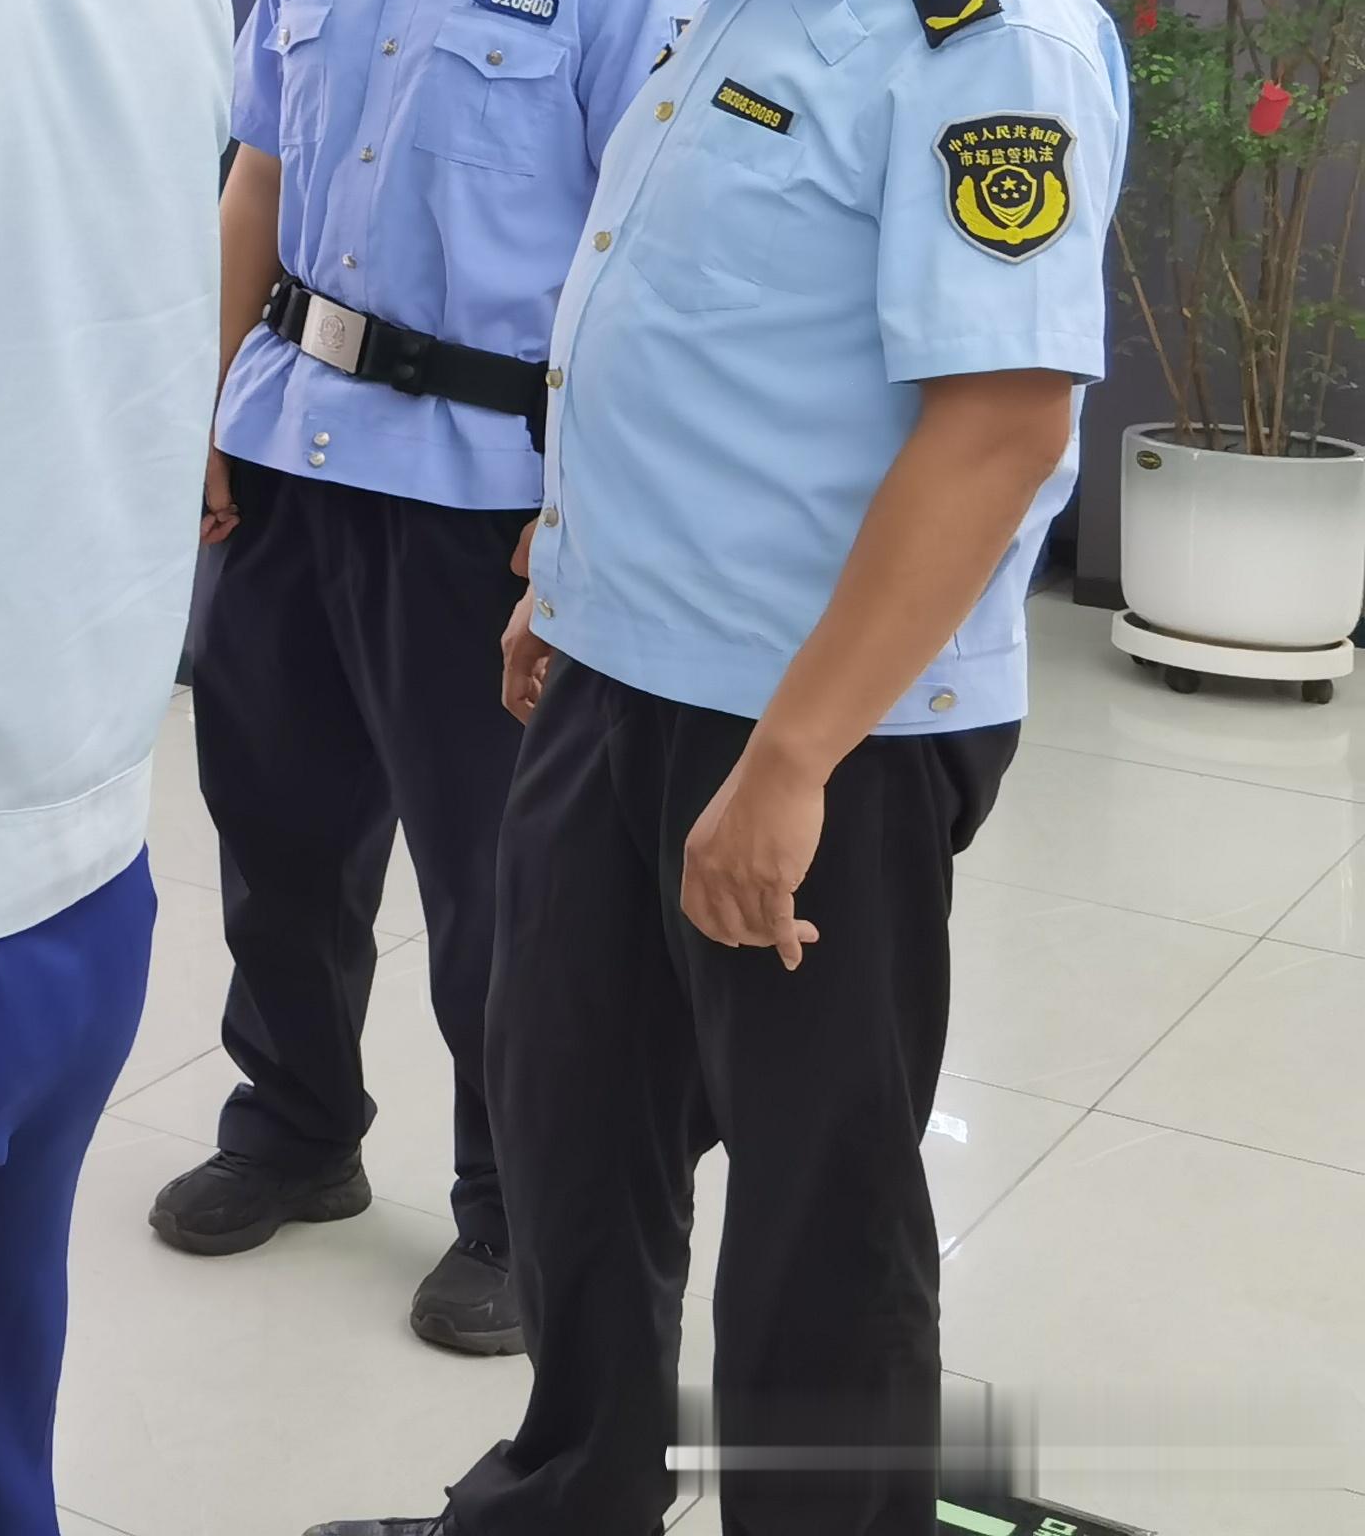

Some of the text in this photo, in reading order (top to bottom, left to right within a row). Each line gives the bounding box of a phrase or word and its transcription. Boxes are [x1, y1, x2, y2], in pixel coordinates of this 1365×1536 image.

[948, 124, 1062, 152] 中华人民共和国
[957, 146, 1055, 167] 市场监管执法
